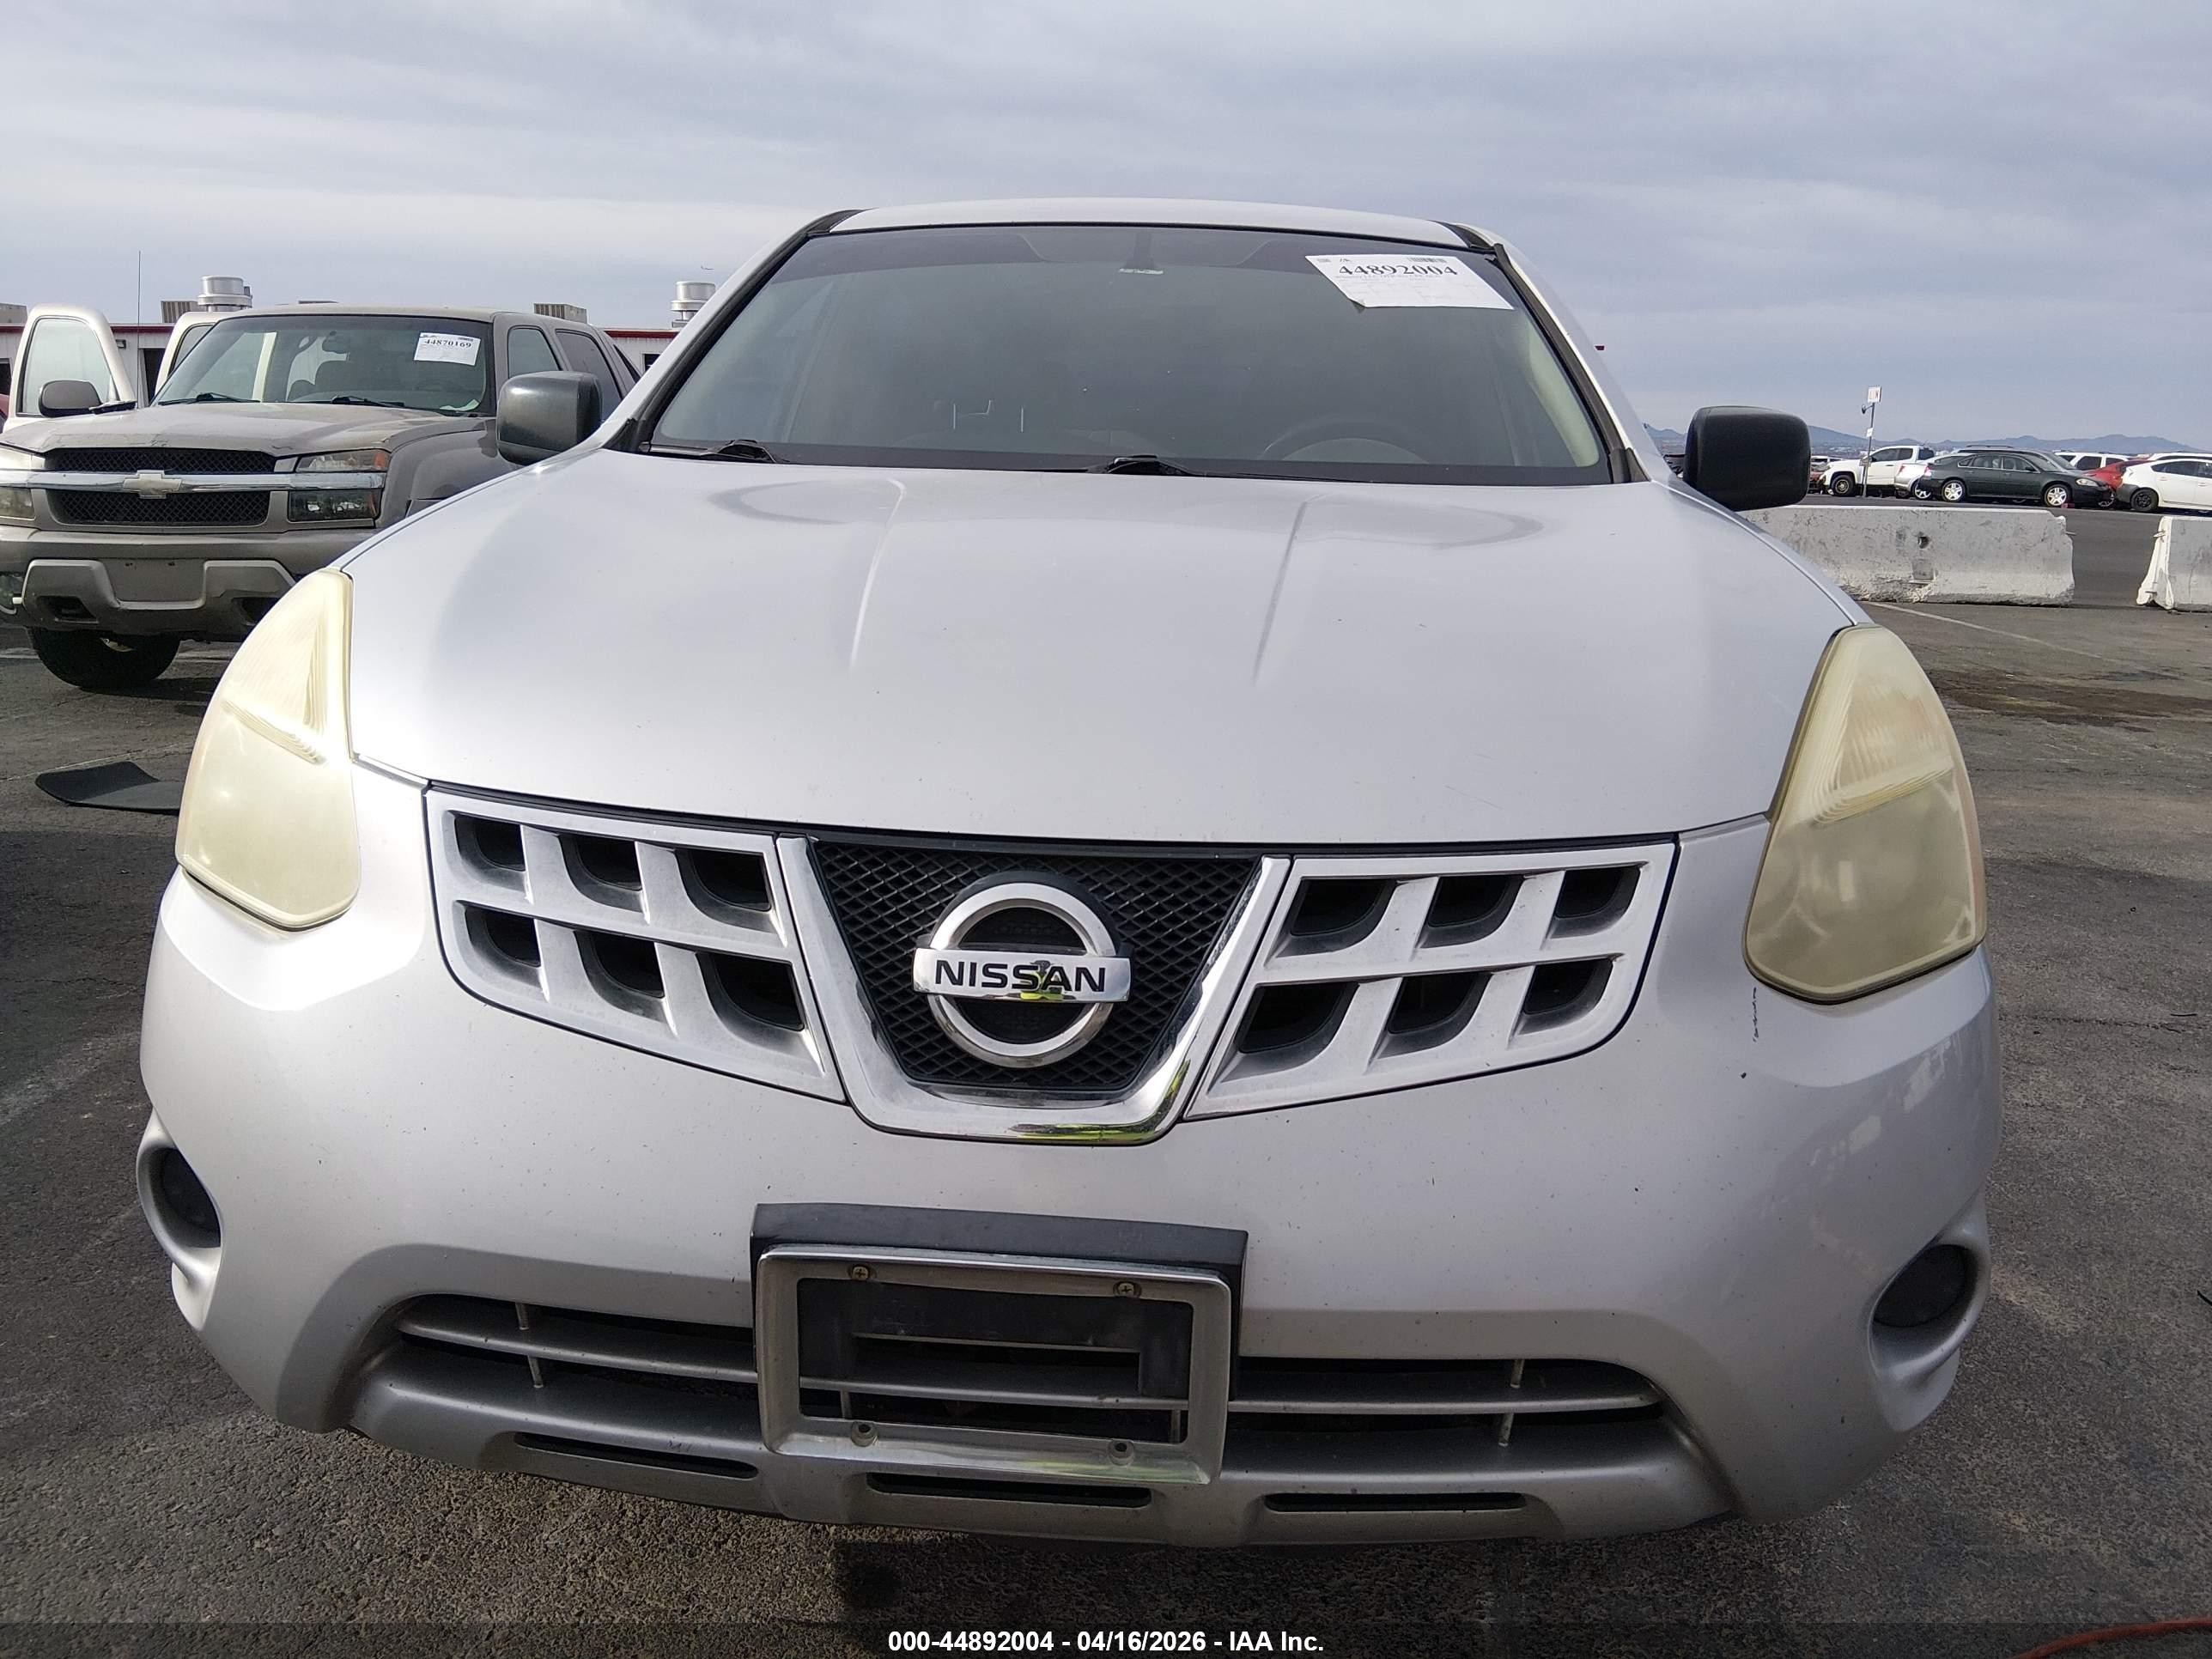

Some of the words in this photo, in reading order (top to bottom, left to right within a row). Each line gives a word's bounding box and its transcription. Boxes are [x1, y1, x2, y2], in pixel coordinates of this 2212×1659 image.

[1339, 264, 1458, 276] 44892004
[424, 339, 471, 348] 44870169
[934, 959, 1106, 993] NISSAN
